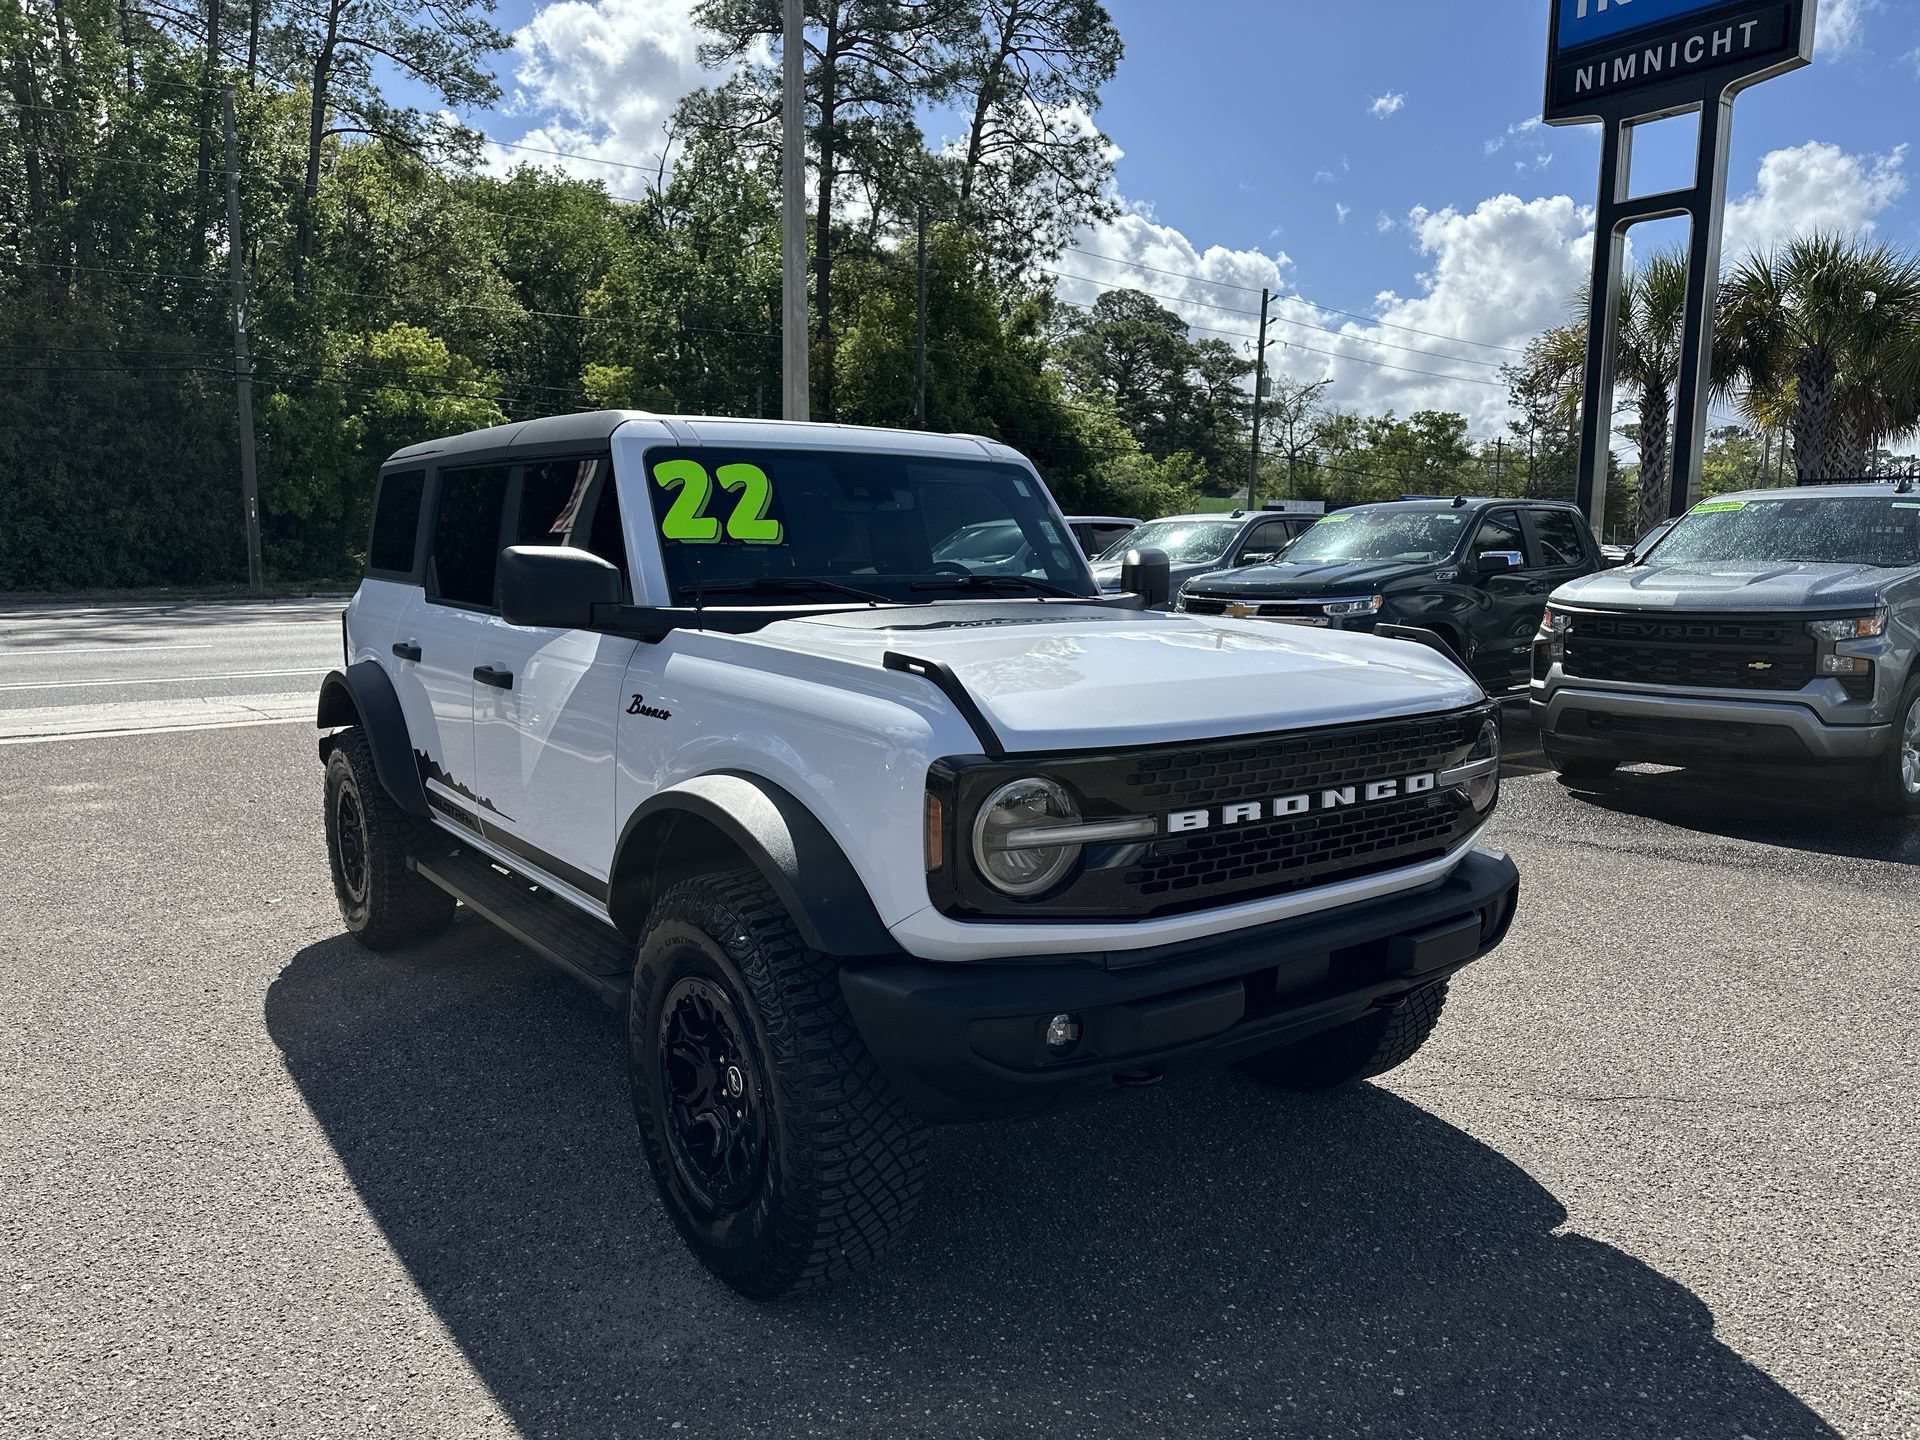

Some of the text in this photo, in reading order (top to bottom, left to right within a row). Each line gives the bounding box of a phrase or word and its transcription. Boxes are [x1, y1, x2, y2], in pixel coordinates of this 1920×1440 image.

[1575, 20, 1758, 93] NIMNICHT
[653, 460, 784, 545] 22
[1576, 621, 1791, 641] CHEVROLET
[626, 694, 671, 720] Bronco
[1167, 773, 1433, 832] BRONCO
